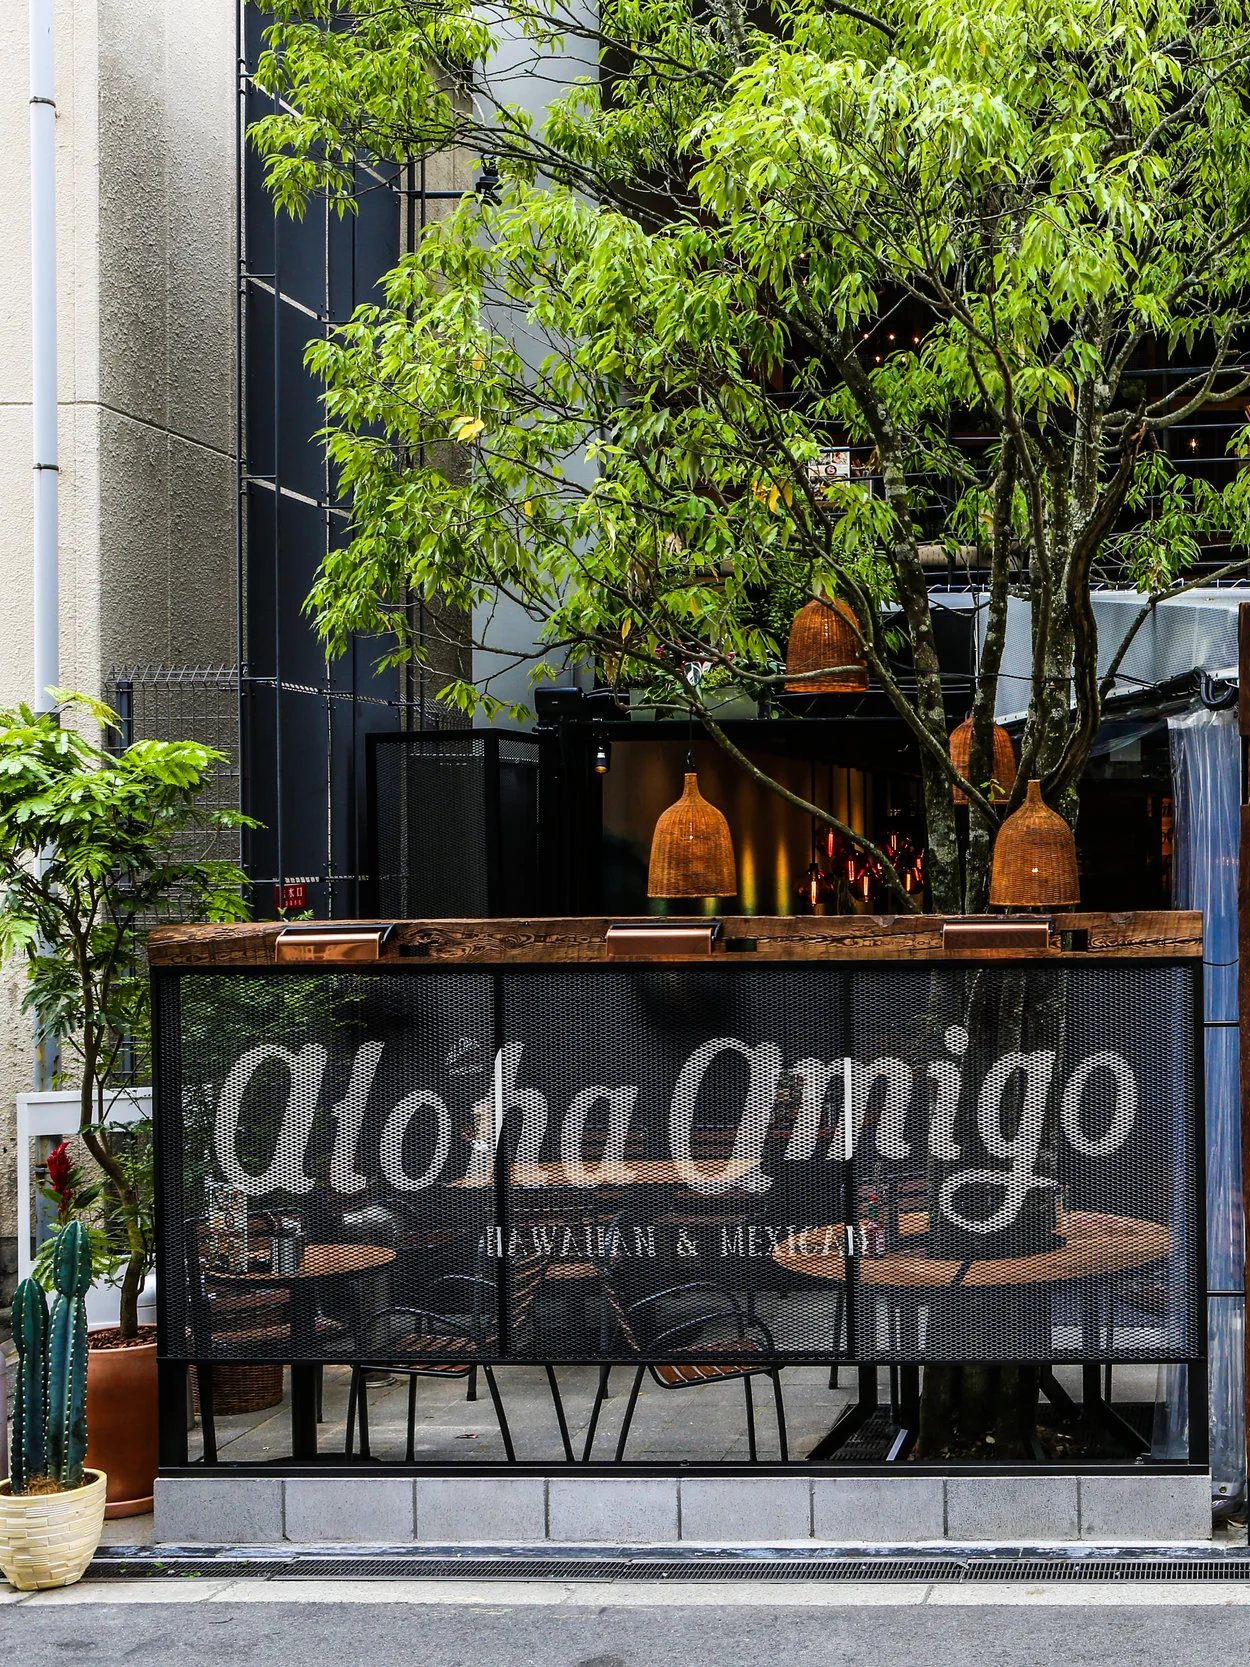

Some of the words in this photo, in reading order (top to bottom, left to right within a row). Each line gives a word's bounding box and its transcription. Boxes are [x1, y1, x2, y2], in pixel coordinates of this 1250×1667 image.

[214, 1039, 638, 1193] Aloha
[667, 1027, 1137, 1233] Amigo
[675, 1226, 698, 1256] &
